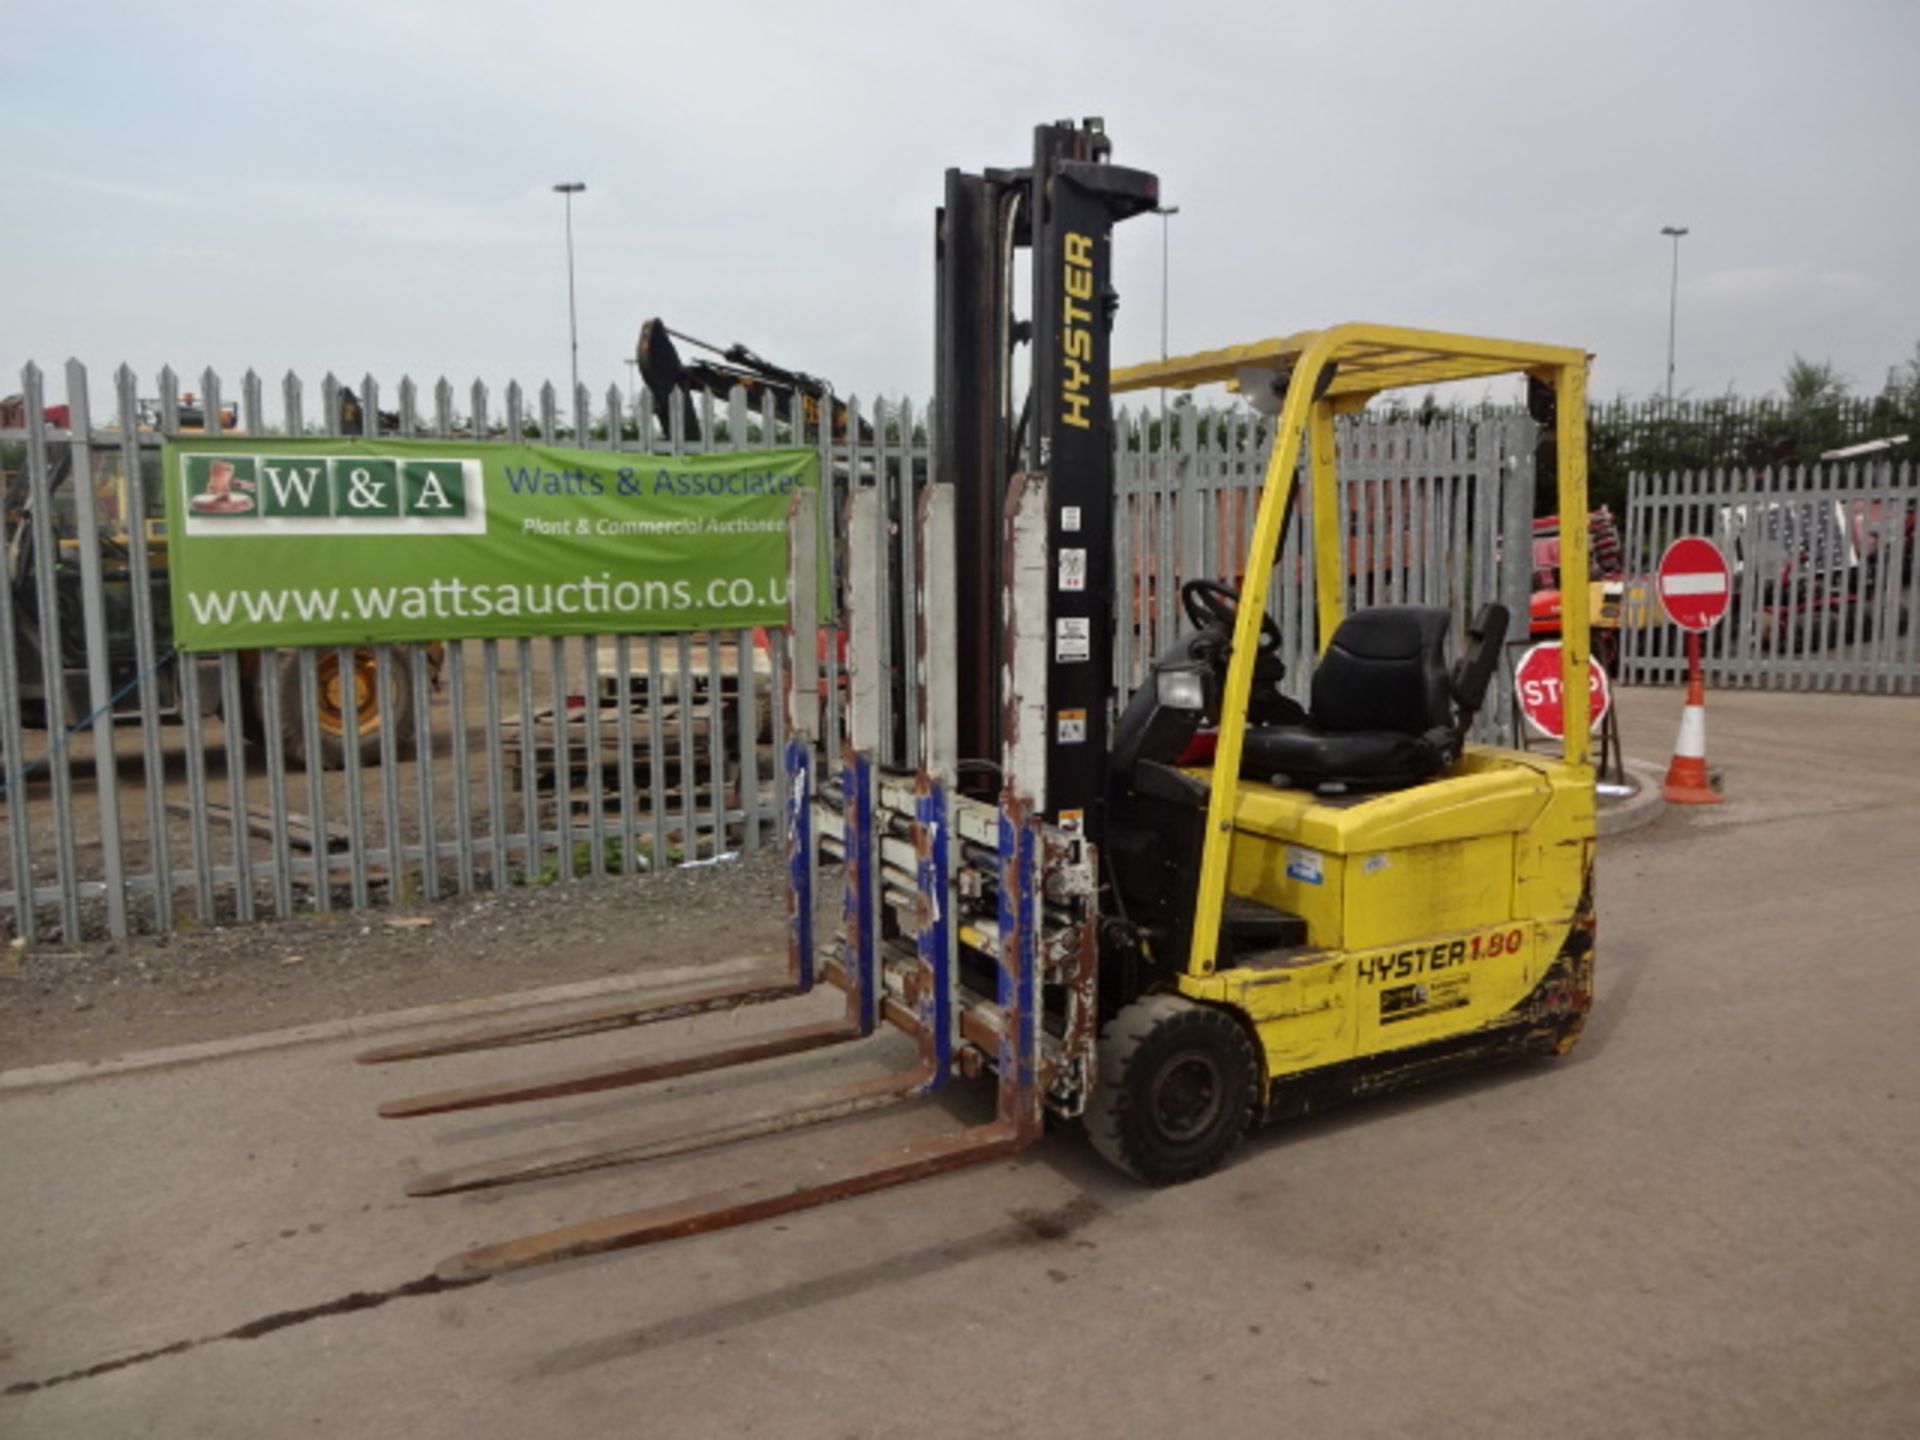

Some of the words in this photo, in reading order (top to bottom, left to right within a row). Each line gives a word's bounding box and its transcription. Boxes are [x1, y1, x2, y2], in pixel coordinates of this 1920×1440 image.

[1062, 232, 1093, 428] HYSTER
[264, 466, 320, 508] W
[347, 467, 387, 509] &
[414, 470, 453, 509] A
[504, 465, 604, 496] Watts
[617, 467, 643, 496] &
[522, 518, 570, 535] Plant
[576, 519, 591, 535] &
[597, 517, 703, 535] Commercial
[188, 571, 788, 625] www.wattsauctions.co.u
[1358, 940, 1466, 984] HYSTER
